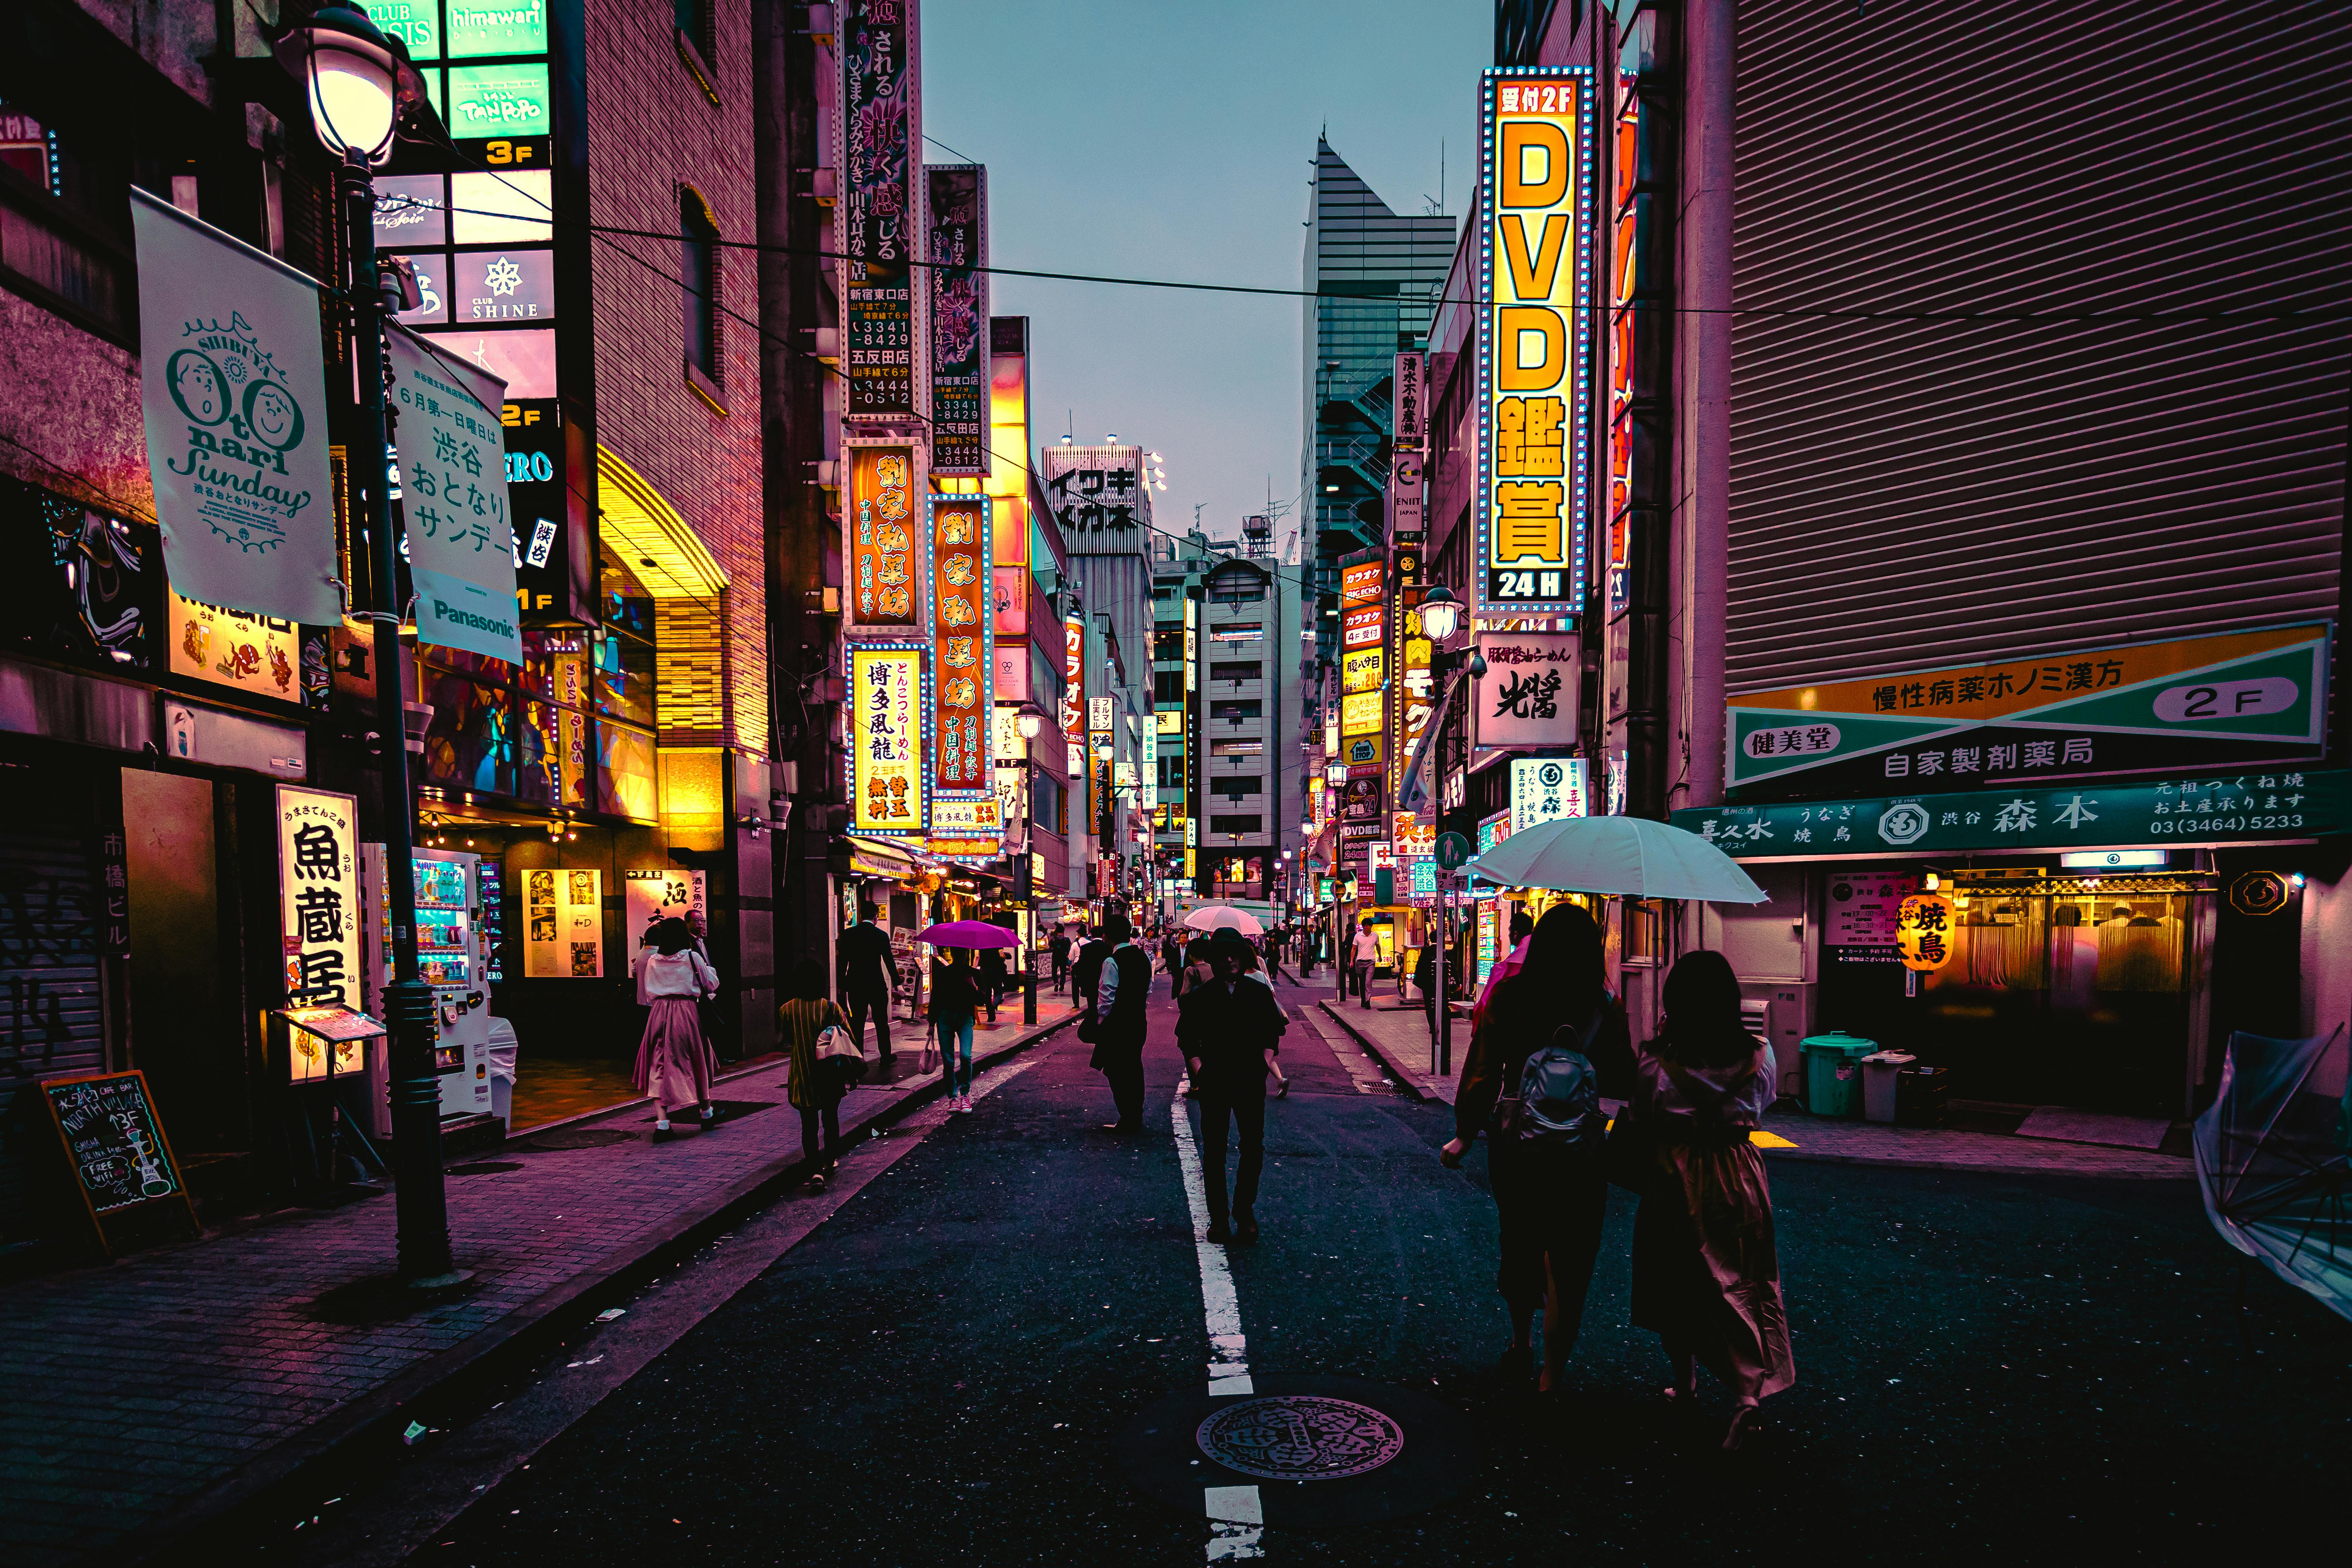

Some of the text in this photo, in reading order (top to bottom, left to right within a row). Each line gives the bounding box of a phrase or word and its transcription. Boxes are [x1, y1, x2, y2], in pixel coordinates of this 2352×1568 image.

[367, 5, 410, 21] CLUB
[452, 0, 541, 27] himawari
[1501, 85, 1571, 113] 受付2F
[486, 140, 533, 164] 3F
[870, 118, 903, 259] 快く感じる
[850, 288, 909, 301] 新宿東口店
[472, 304, 538, 319] SHINE
[1497, 120, 1571, 563] DVD鑑賞
[198, 335, 271, 379] SHIBUYA
[852, 350, 909, 365] 五反田店
[853, 368, 909, 377] 山手線で6分
[935, 376, 979, 385] 新宿東口店
[1400, 357, 1418, 435] 清水不動産(株)
[400, 387, 497, 445] 6月第一日曜日は
[501, 405, 540, 427] 2F
[935, 423, 979, 434] 五反田店
[432, 426, 483, 478] 渋谷
[167, 448, 311, 519] Sunday
[1048, 466, 1135, 497] イワキ
[411, 461, 504, 525] おとなり
[1396, 497, 1421, 506] ENIIT
[414, 505, 509, 555] サンデー
[859, 499, 872, 545] 中国料理
[1346, 568, 1381, 584] カラオケ
[516, 588, 552, 610] 1F
[1346, 589, 1361, 601] BIG
[1361, 584, 1381, 597] ECHO
[434, 599, 514, 640] Panasonic
[1346, 611, 1381, 626] カラオケ
[1362, 628, 1378, 639] 受付
[1347, 655, 1380, 673] 腹八分目
[1487, 647, 1572, 664] 豚骨醤油らーめん
[1067, 628, 1081, 728] カラオケ
[1872, 658, 2124, 712] 慢性病薬ホノミ漢方
[867, 662, 896, 760] 博多風龍
[897, 662, 909, 761] とんこつらーめん
[1359, 707, 1382, 717] センター
[2183, 687, 2264, 718] 2F
[945, 717, 960, 780] 中国料理
[1069, 734, 1084, 743] ECHO
[1751, 726, 1832, 757] 健美堂
[1001, 759, 1017, 768] 1F
[1355, 751, 1371, 760] STOP
[1885, 737, 2093, 778] 自家製剤薬局
[2154, 772, 2305, 796] 元祖つくね焼
[1349, 799, 1375, 815] 宝島24
[1721, 806, 1754, 817] 信州の酒
[1801, 805, 1856, 824] うなぎ
[1993, 795, 2099, 833] 森本
[2154, 793, 2306, 816] お土産承ります
[934, 813, 974, 822] 博多風龍
[1942, 811, 1982, 827] 渋谷
[2150, 815, 2304, 835] 03(3464)5233
[1344, 825, 1380, 836] DVD鑑賞
[1700, 816, 1775, 842] 喜久水
[1793, 825, 1851, 844] 焼鳥
[1344, 850, 1368, 859] 24時間
[1717, 841, 1748, 850] キクスイ
[1417, 864, 1437, 876] 金太
[104, 833, 127, 945] 市橋ビル
[692, 876, 703, 913] 酒と魚の
[1417, 877, 1437, 890] 渋谷
[294, 822, 345, 1008] 魚蔵居
[1912, 903, 1948, 964] 焼鳥
[119, 1083, 133, 1092] BAR
[89, 1161, 114, 1175] FREE
